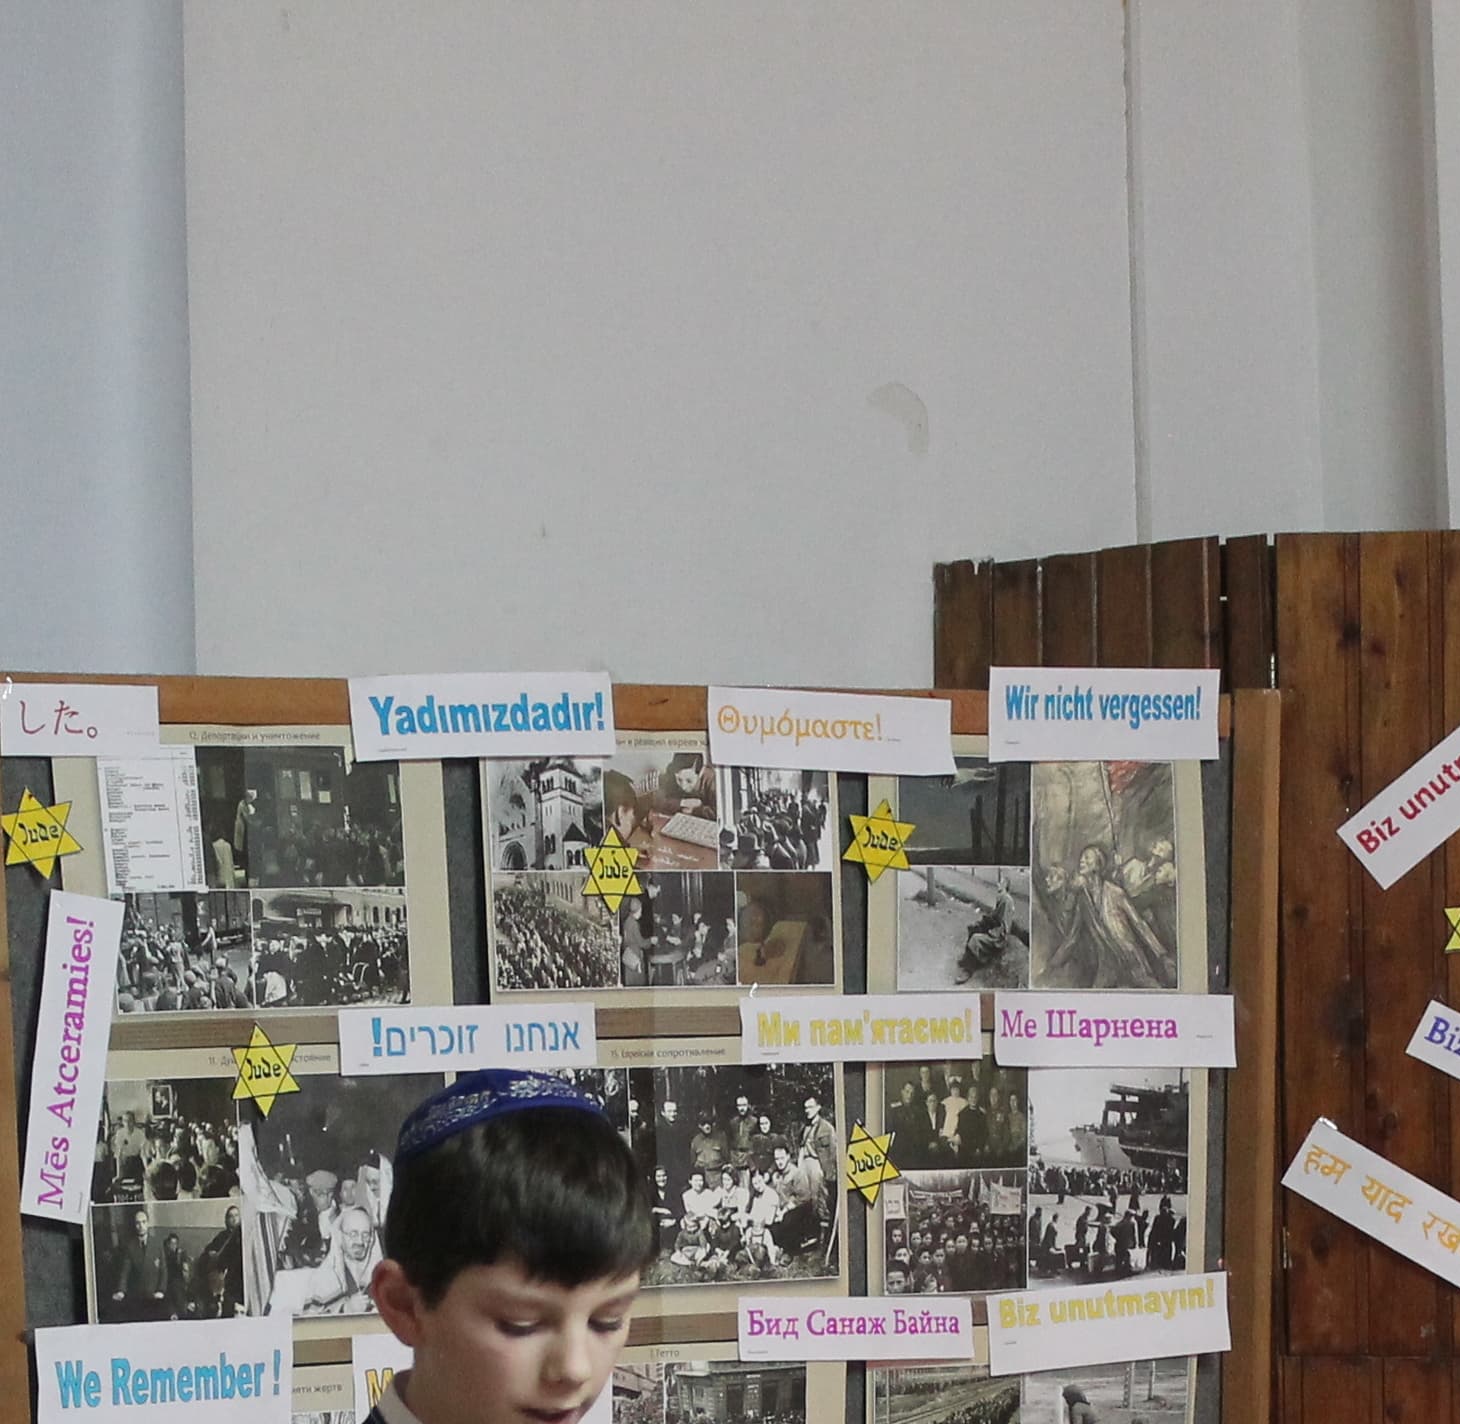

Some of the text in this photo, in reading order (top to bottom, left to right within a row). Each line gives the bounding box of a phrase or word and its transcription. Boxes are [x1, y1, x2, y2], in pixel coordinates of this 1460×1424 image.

[20, 700, 97, 739] した。
[368, 692, 604, 736] Yadımızdadır!
[717, 705, 882, 746] Θυμόμαστε!
[1006, 685, 1201, 730] Wir nicht vergessen!
[18, 822, 60, 845] Jude
[863, 826, 898, 850] Jude
[1356, 817, 1400, 854] Biz
[599, 857, 629, 879] Jude
[372, 1017, 580, 1056] אנחנו זוכרים!
[758, 1012, 800, 1045] Ми
[1001, 1009, 1178, 1046] Ме Шарнена
[38, 916, 94, 1209] Mēs Atceramies!
[246, 1056, 281, 1080] Jude
[849, 1151, 883, 1175] Jude
[1304, 1144, 1352, 1184] हम
[1361, 1175, 1413, 1223] याद
[998, 1278, 1215, 1330] Biz unutmayın!
[747, 1309, 960, 1339] Бид Санаж Байна
[55, 1360, 101, 1409] We
